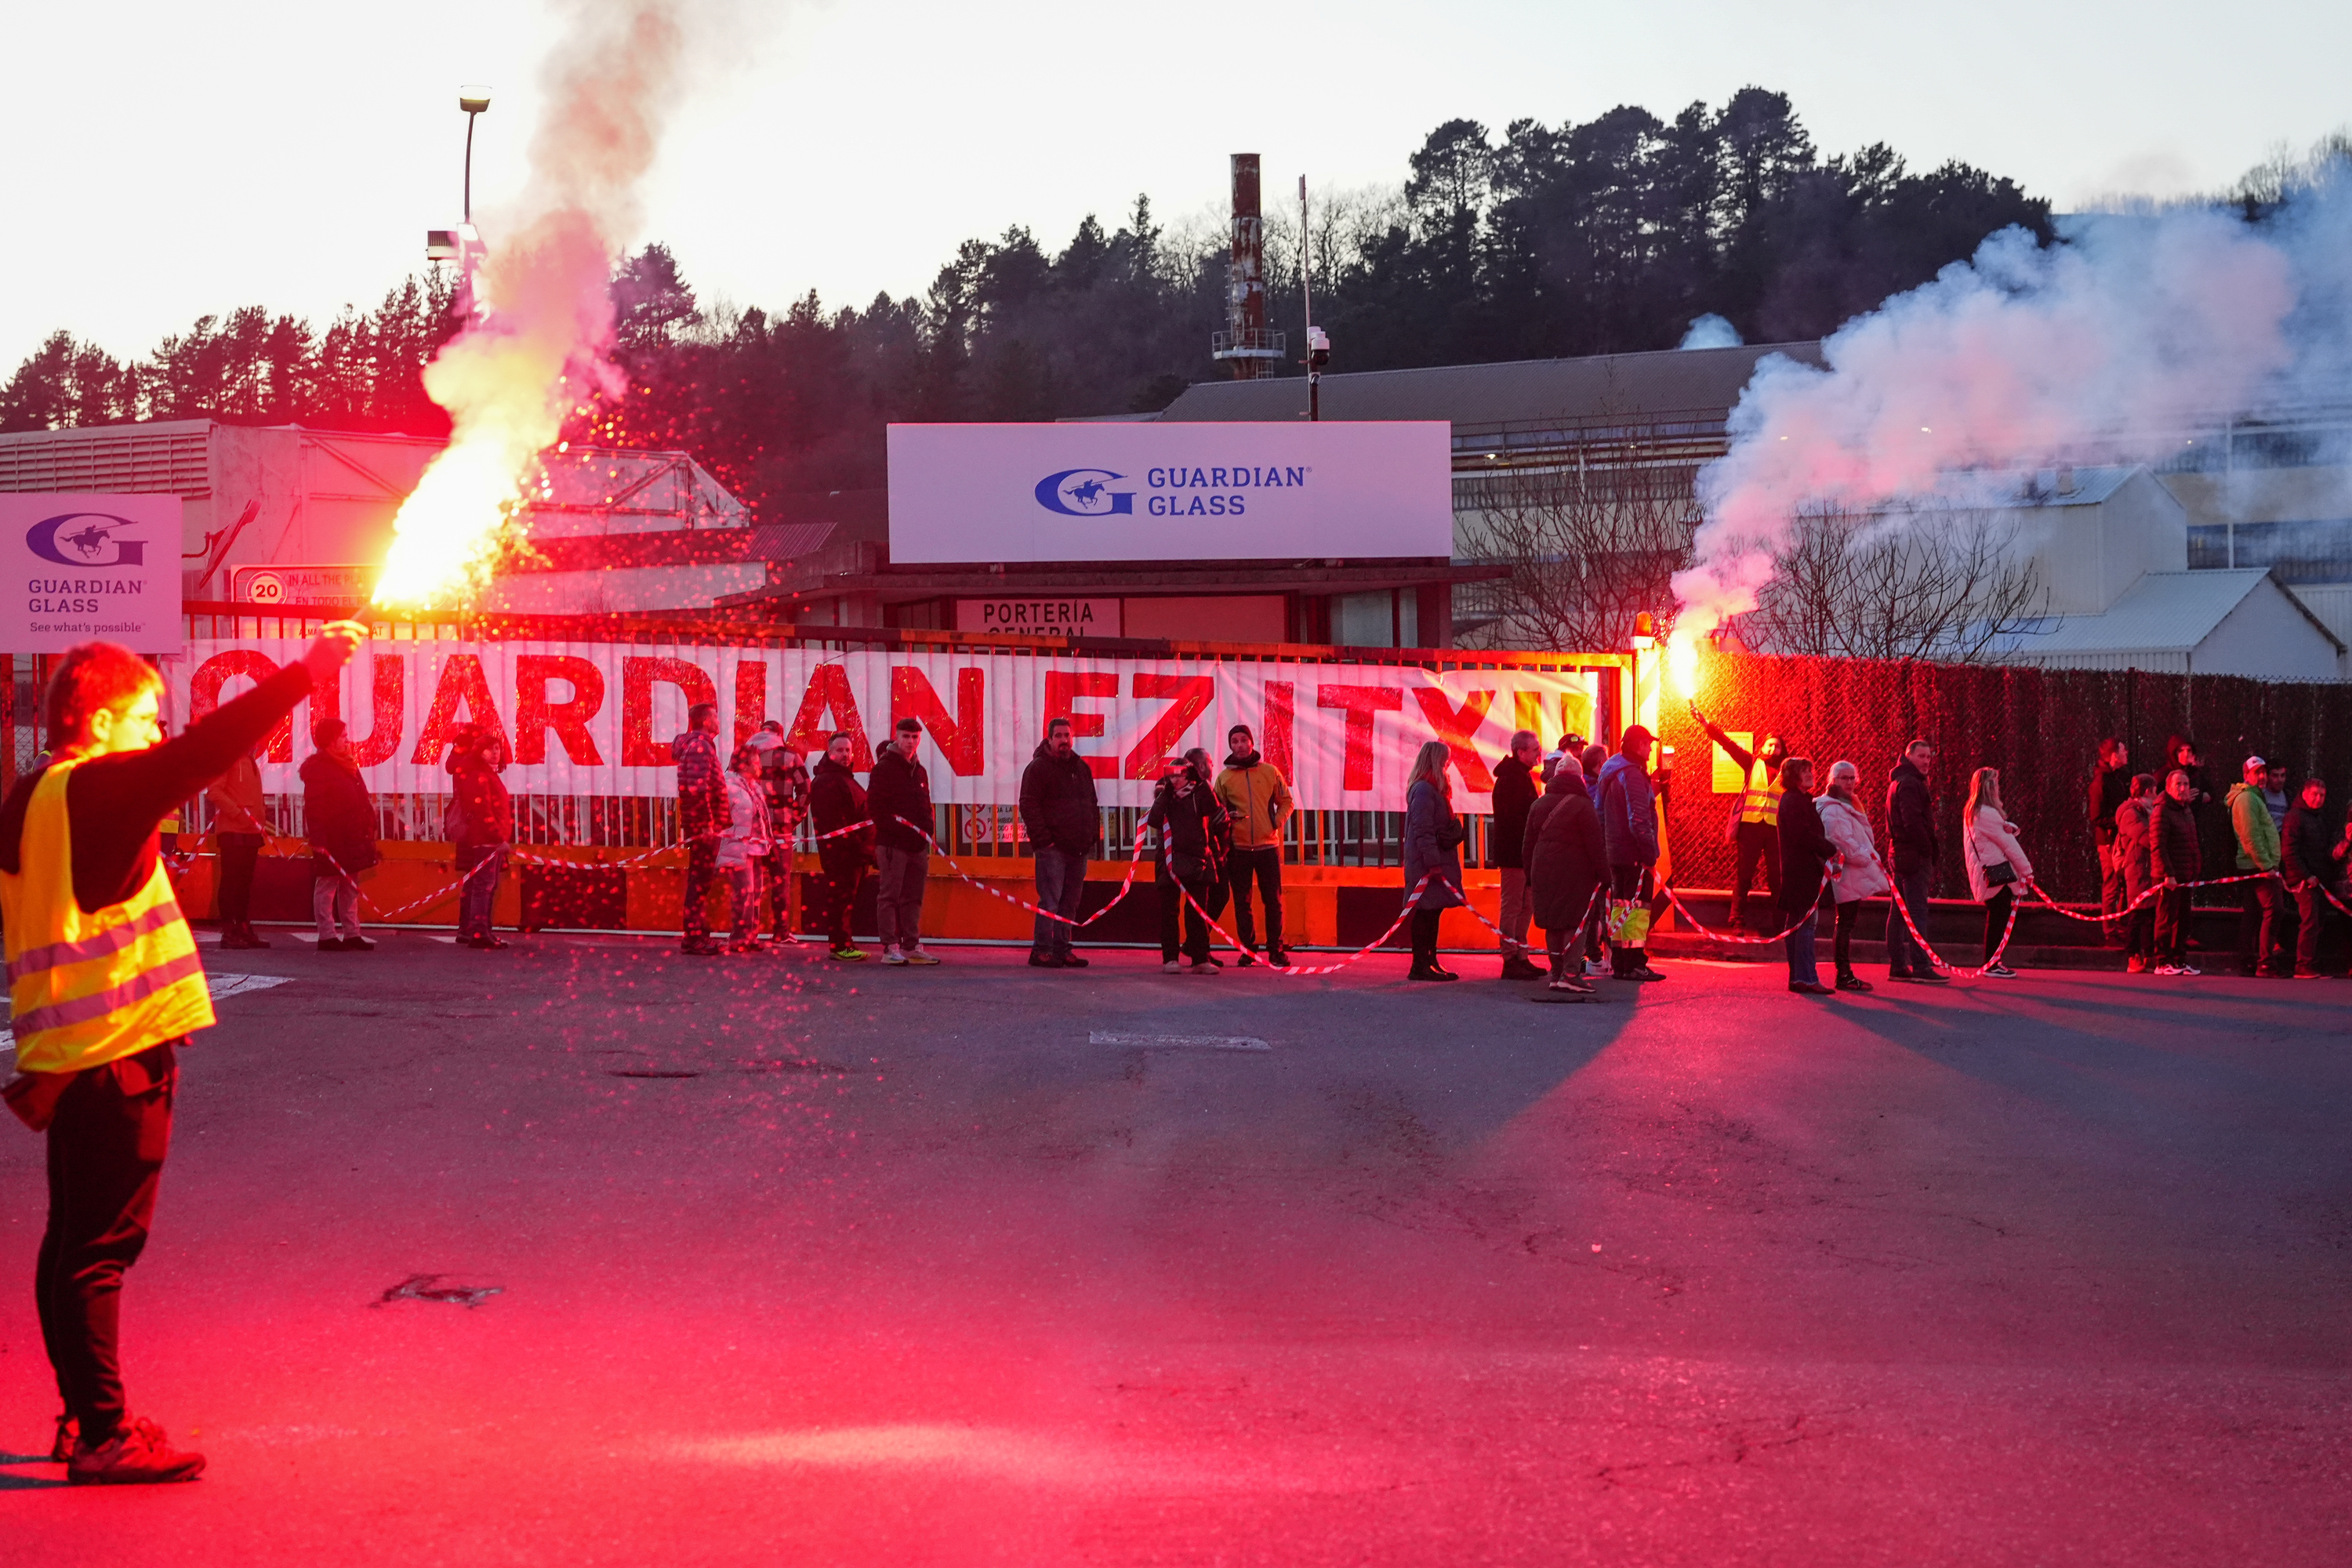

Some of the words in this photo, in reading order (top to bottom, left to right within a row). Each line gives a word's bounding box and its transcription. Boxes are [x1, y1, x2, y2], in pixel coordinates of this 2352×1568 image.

[1148, 495, 1246, 516] GLASS
[301, 575, 320, 586] ALL
[322, 574, 342, 585] THE
[255, 583, 278, 597] 20
[28, 598, 99, 612] GLASS
[983, 599, 1094, 623] PORTERÍA
[30, 622, 51, 633] See
[54, 622, 91, 633] what's
[1044, 670, 1214, 781] EZ
